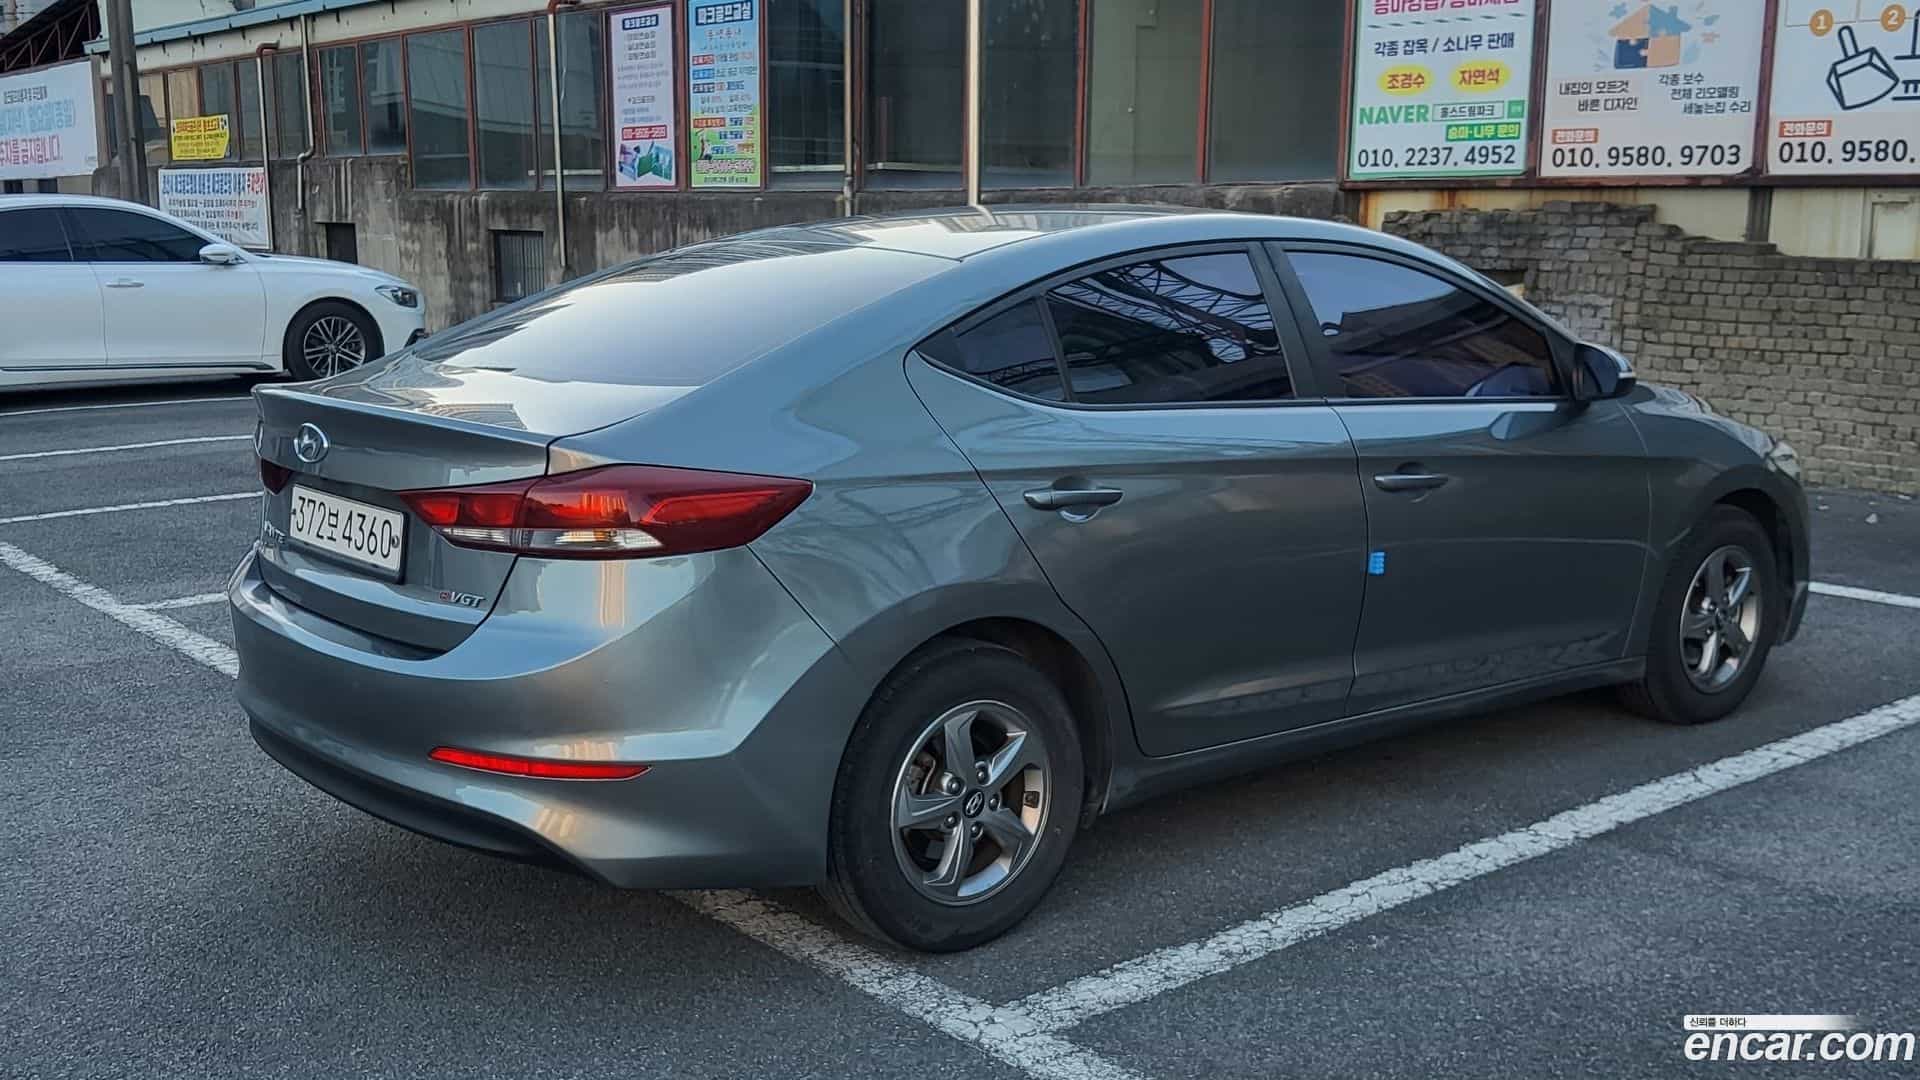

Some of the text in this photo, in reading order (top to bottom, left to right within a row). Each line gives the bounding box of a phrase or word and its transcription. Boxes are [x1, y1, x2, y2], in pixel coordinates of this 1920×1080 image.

[1374, 32, 1515, 57] 각종 잡목 / 소나무 판매
[1387, 73, 1425, 89] 조경수
[1459, 68, 1500, 85] 자연석
[1659, 72, 1704, 86] 각종 보수
[1559, 80, 1629, 95] 내집의 모든것
[1577, 97, 1638, 112] 바른 디자인
[1729, 100, 1751, 113] 수리
[1359, 104, 1429, 125] NAVER
[1358, 144, 1516, 168] 010. 2237. 4952
[1552, 144, 1741, 168] 010. 9580. 9703
[1779, 139, 1915, 164] 010. 9580.
